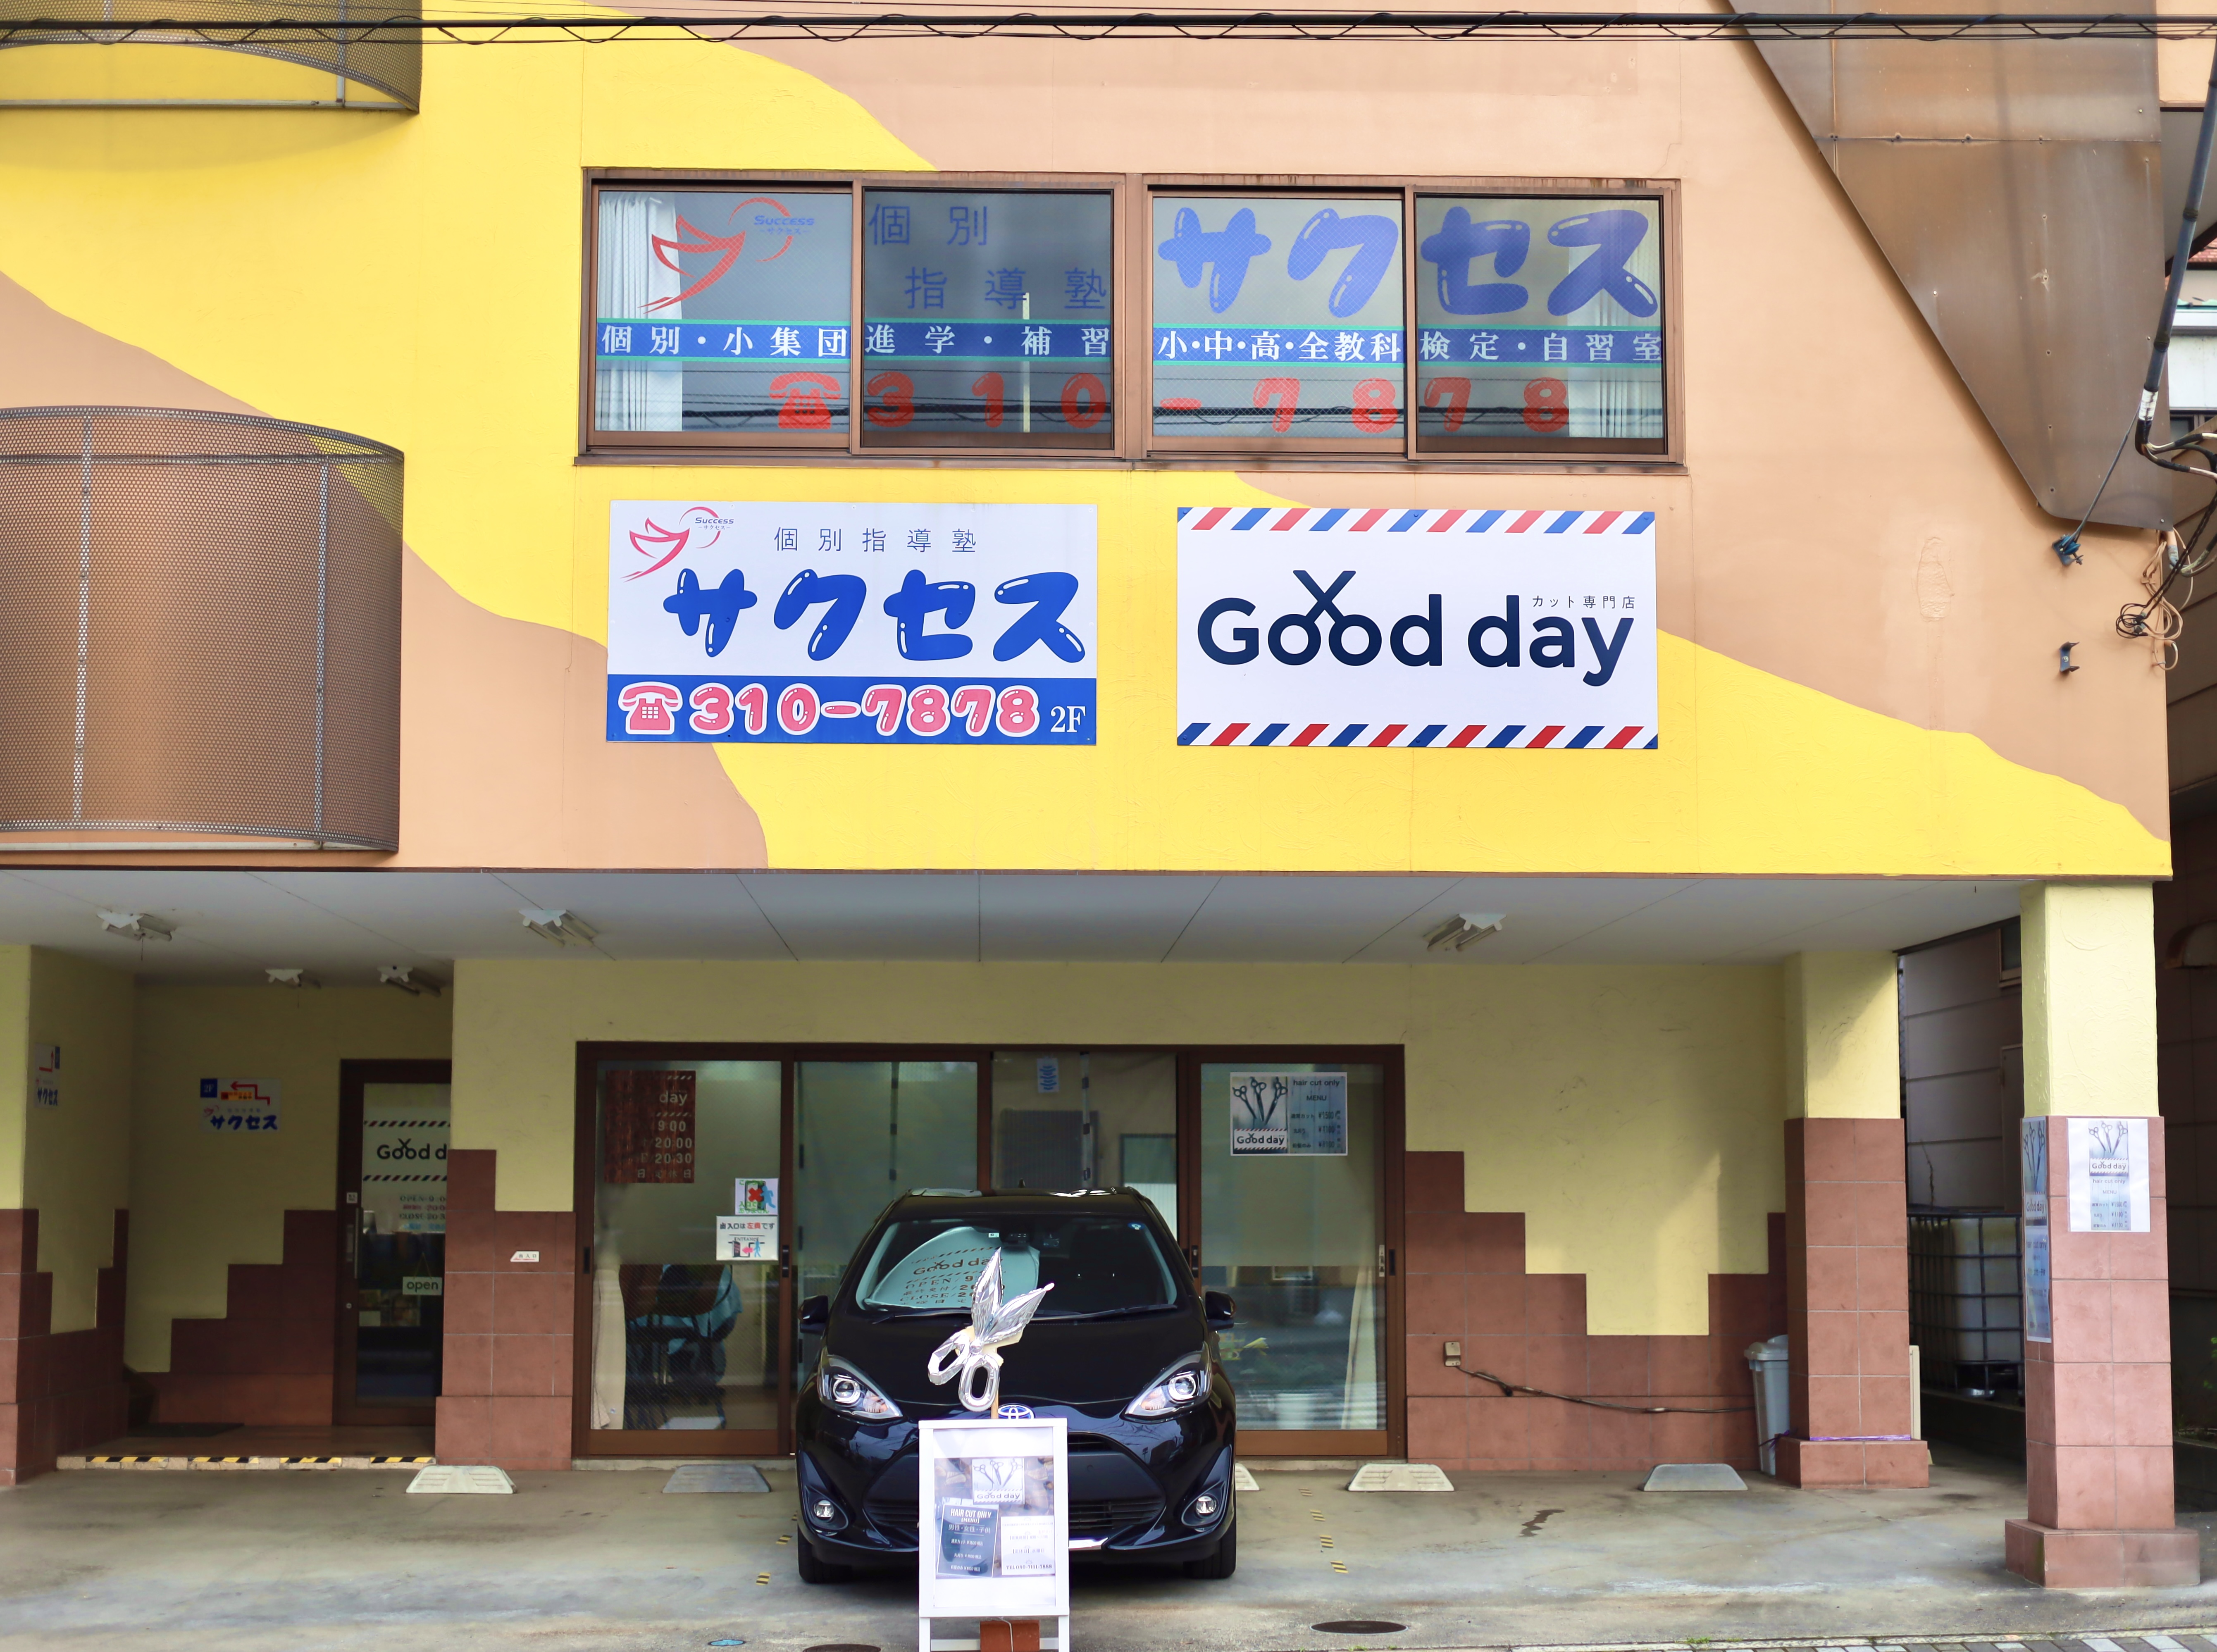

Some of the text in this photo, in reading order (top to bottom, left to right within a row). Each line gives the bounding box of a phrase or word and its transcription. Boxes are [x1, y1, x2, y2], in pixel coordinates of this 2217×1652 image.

[754, 215, 815, 226] Success
[868, 203, 988, 246] 個別
[1158, 206, 1658, 318] サクセス
[904, 267, 1107, 310] 指導塾
[601, 324, 848, 358] 個別・小集団
[864, 324, 1111, 357] 進学・補習
[1420, 331, 1663, 362] 検定・自習室
[774, 526, 977, 553] 個別指導塾
[1532, 595, 1635, 609] カット専門店
[663, 568, 1085, 663] サクセス
[1197, 570, 1634, 687] Good day
[1049, 705, 1087, 733] 2F
[659, 1090, 687, 1106] day
[210, 1115, 278, 1130] サクセス
[377, 1138, 430, 1160] Good
[1237, 1133, 1285, 1145] Good day
[2092, 1161, 2112, 1169] Good
[913, 1259, 964, 1275] Good
[407, 1280, 439, 1293] open
[950, 1508, 964, 1517] HAIR
[965, 1509, 976, 1518] CUT
